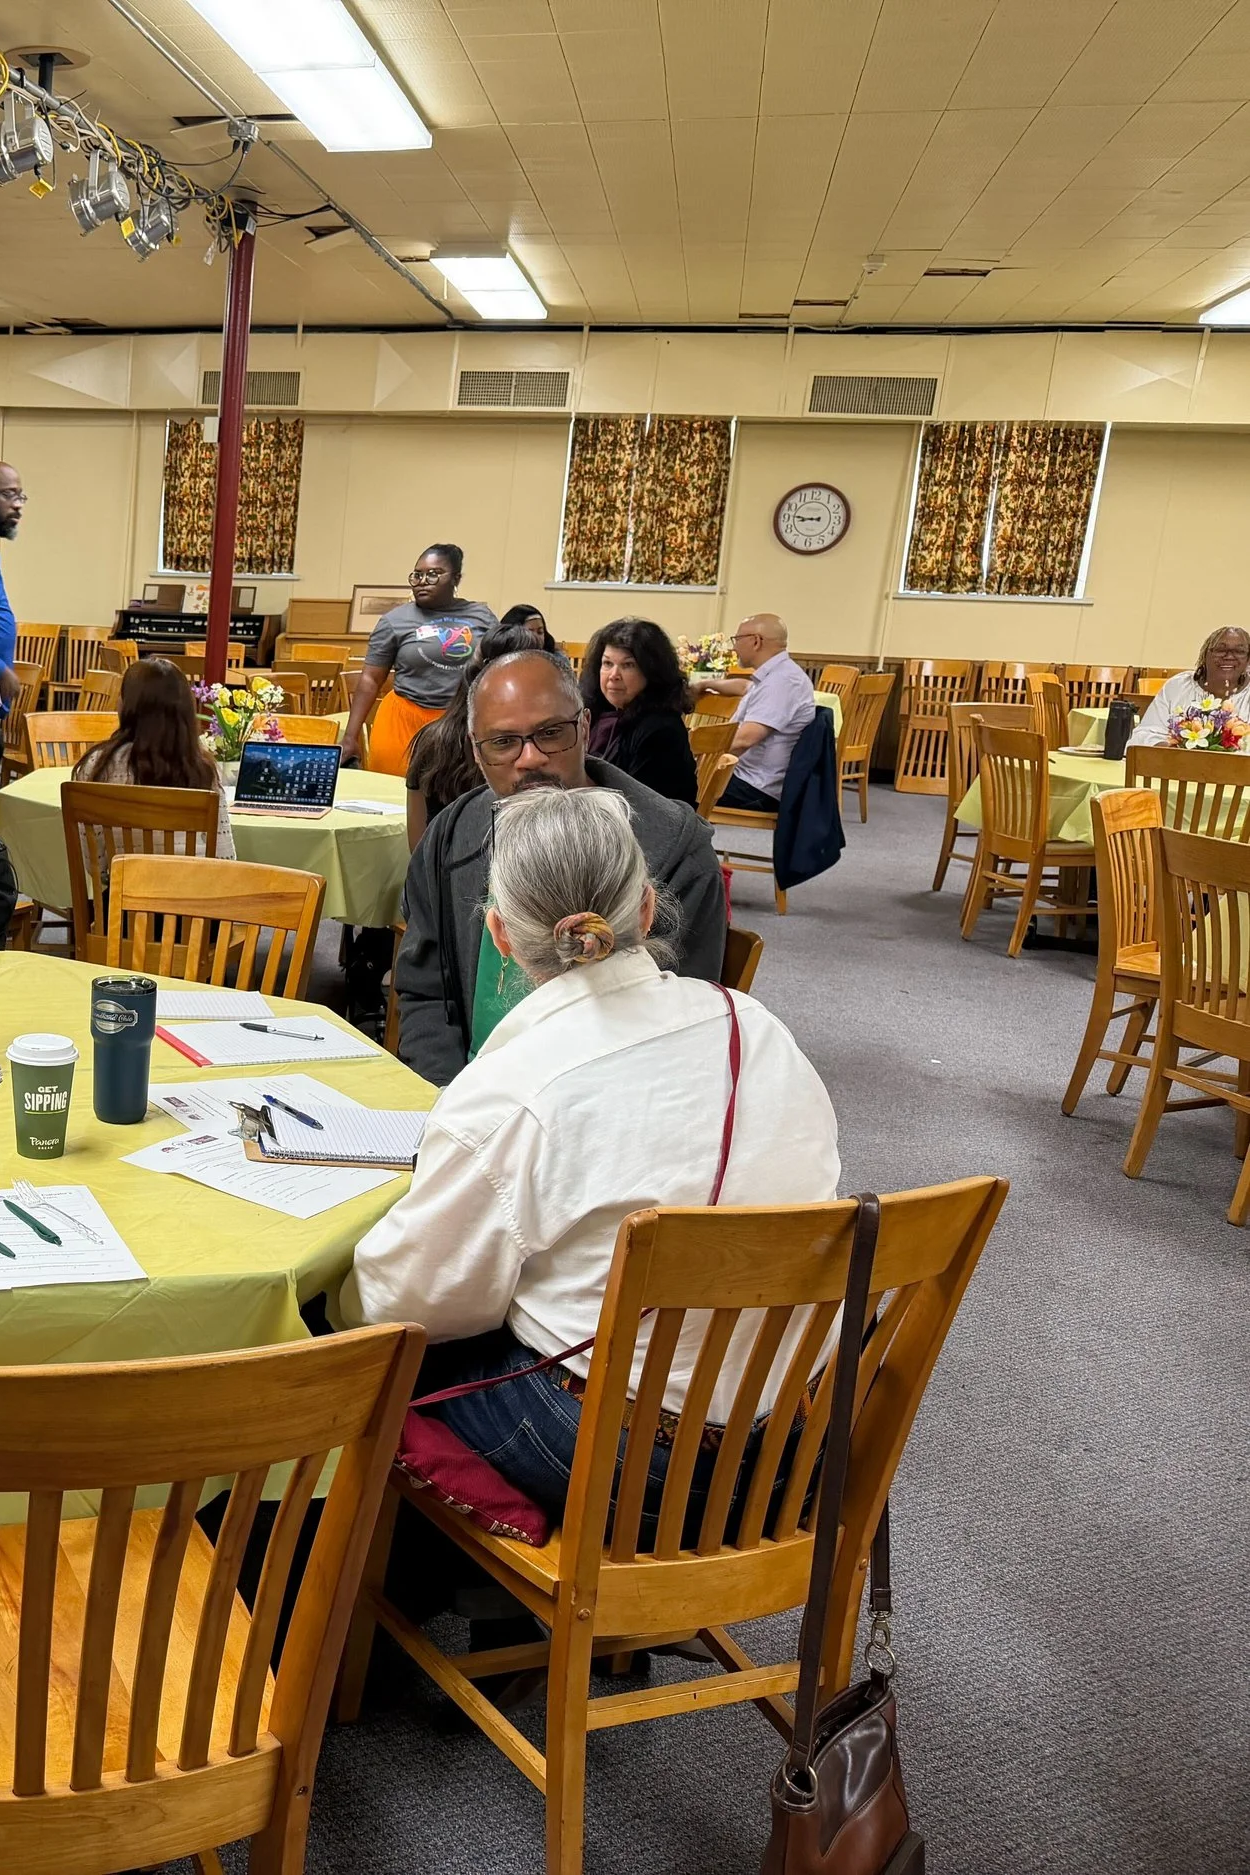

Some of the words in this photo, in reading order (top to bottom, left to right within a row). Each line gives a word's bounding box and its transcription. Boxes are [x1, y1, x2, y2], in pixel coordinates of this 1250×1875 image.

[799, 491, 807, 503] 11
[811, 490, 822, 500] 12
[787, 502, 798, 512] 10
[832, 504, 840, 514] 2
[782, 513, 790, 523] 9
[833, 515, 841, 525] 3
[785, 524, 793, 533] 8
[792, 534, 800, 544] 7
[804, 537, 812, 547] 6
[817, 535, 825, 545] 5
[37, 1085, 58, 1093] GET
[24, 1091, 68, 1111] SIPPING
[29, 1136, 60, 1146] Panera
